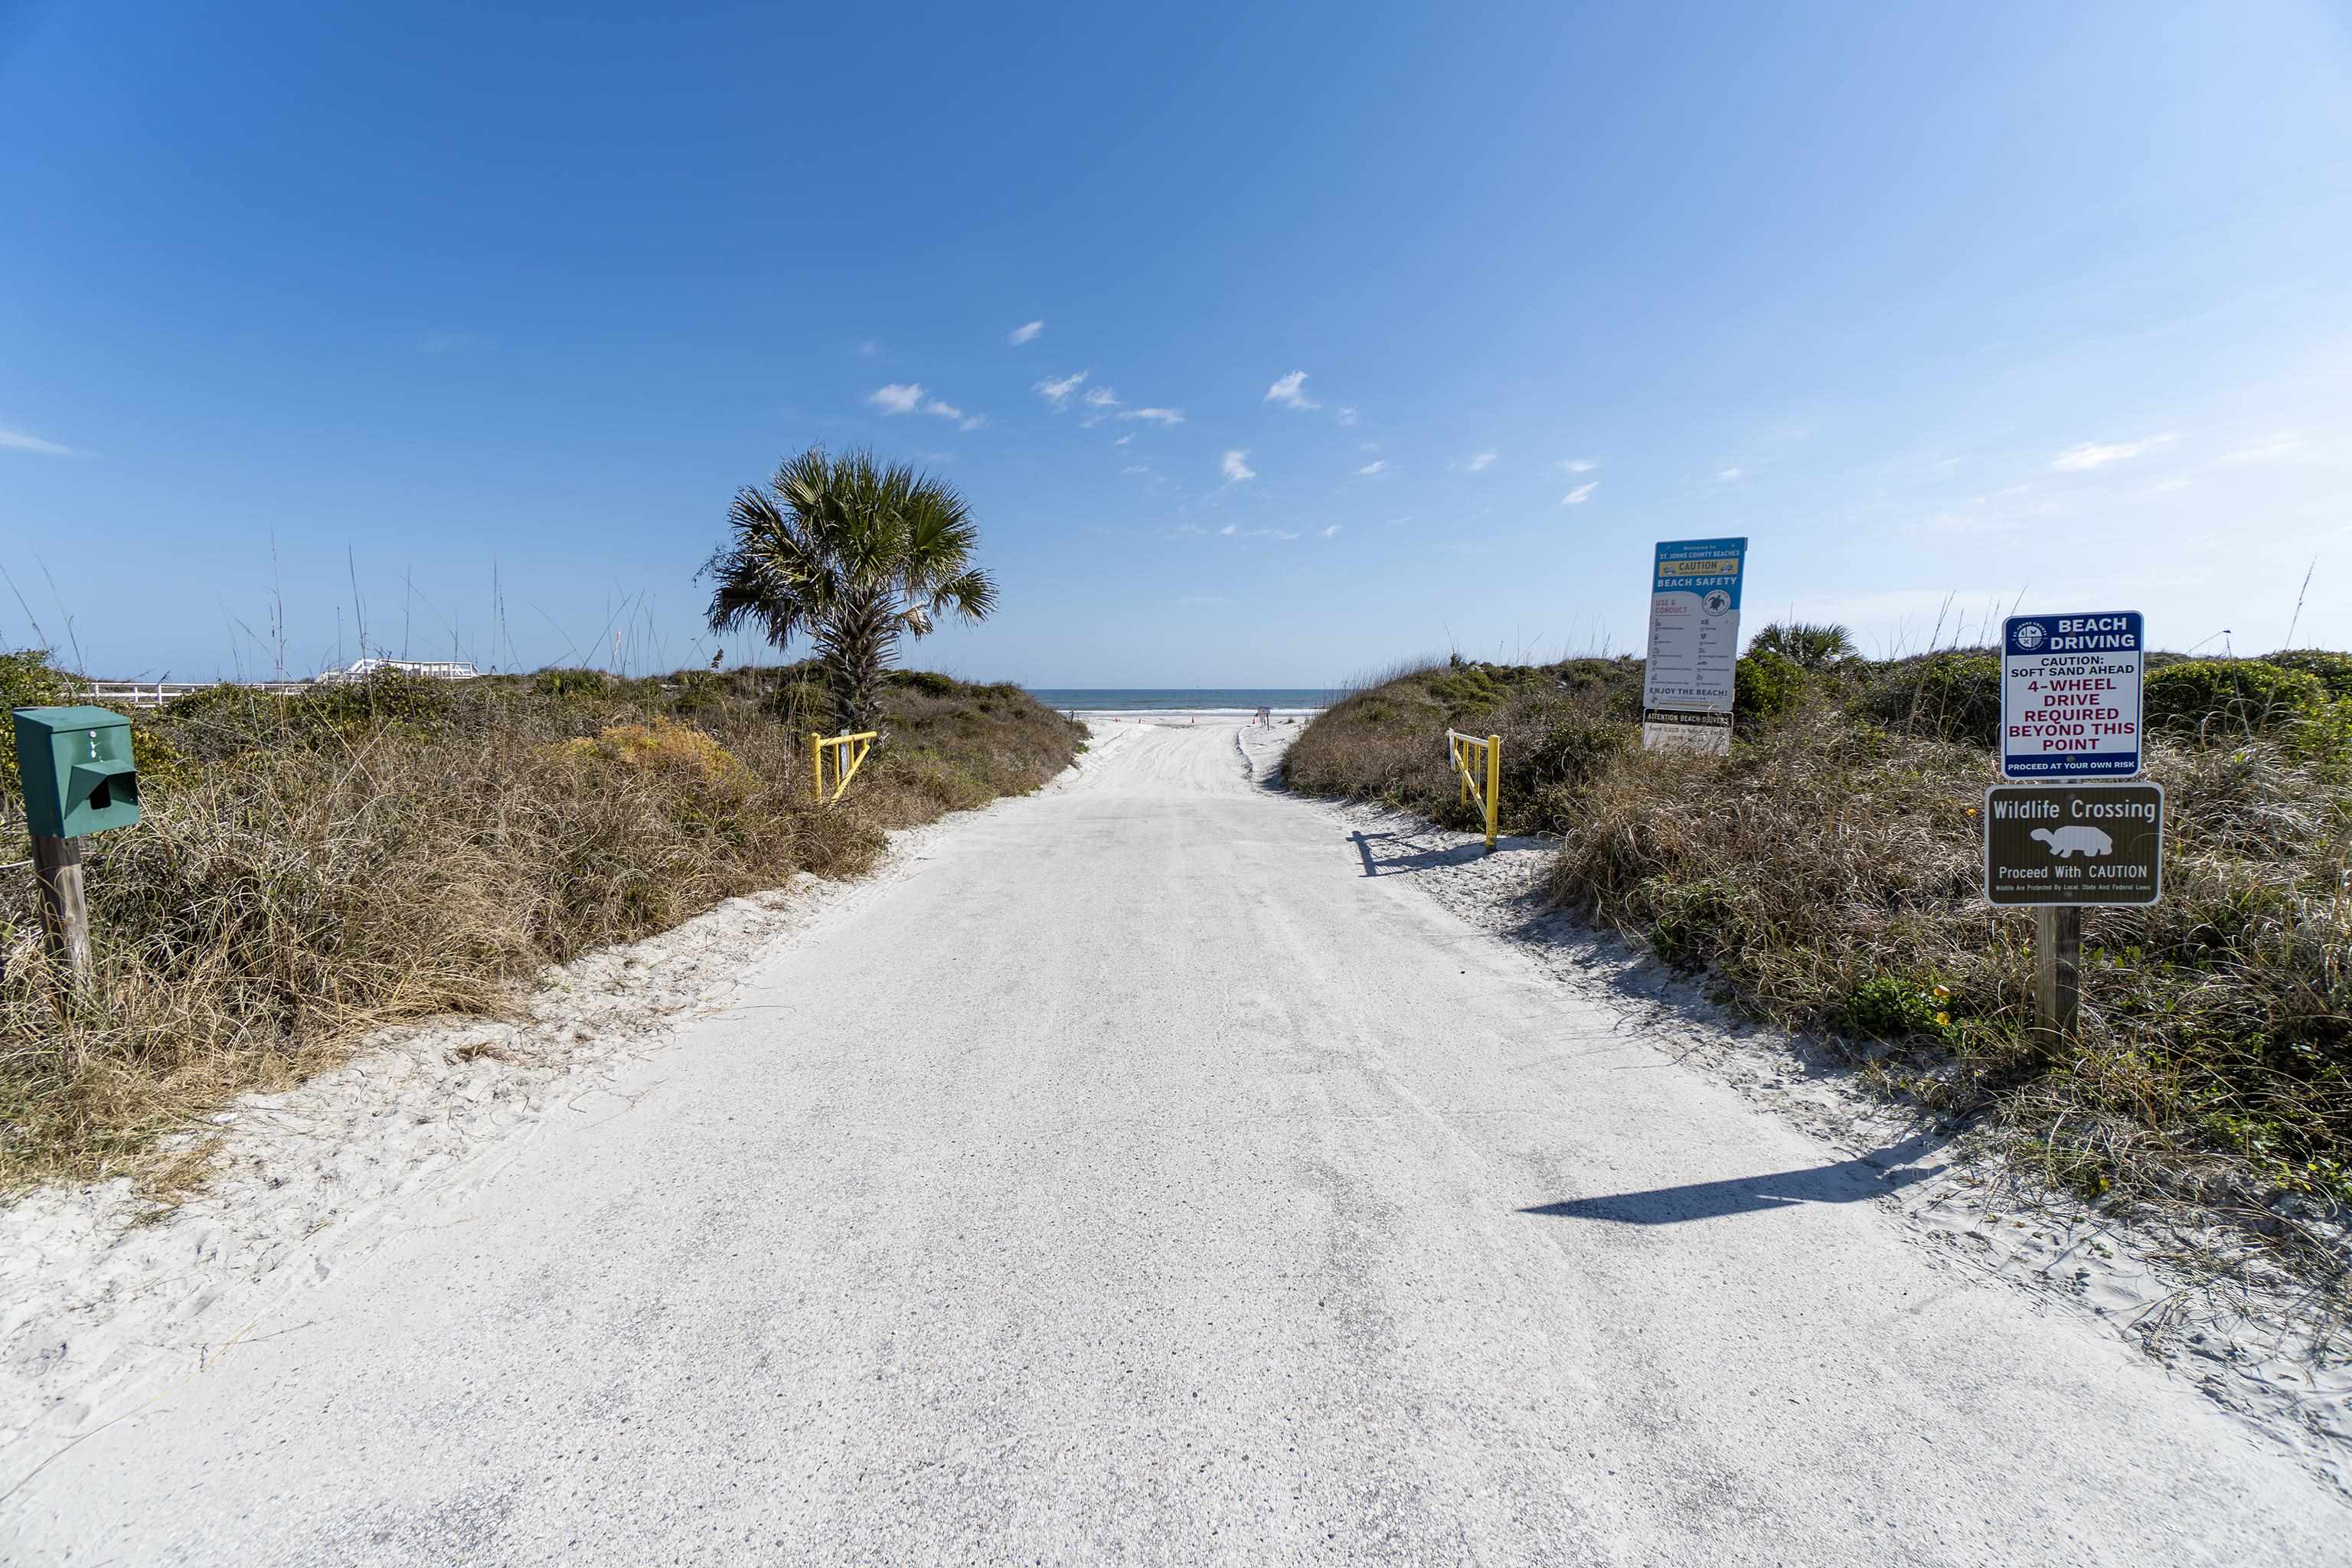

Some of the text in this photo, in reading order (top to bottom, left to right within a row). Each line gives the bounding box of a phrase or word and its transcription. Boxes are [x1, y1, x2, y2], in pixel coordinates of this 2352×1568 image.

[1679, 560, 1717, 570] CAUTION
[1658, 577, 1737, 587] BEACH SAFETY
[1655, 606, 1688, 614] CONDUCT
[2059, 618, 2127, 632] BEACH
[2050, 634, 2135, 650] DRIVING
[2040, 656, 2104, 666] CAUTION:
[2011, 665, 2135, 678] SOFT SAND AHEAD
[2027, 678, 2117, 692] 4-WHEEL
[2044, 694, 2100, 707] DRIVE
[1647, 713, 1678, 721] ATTENTION
[2024, 708, 2119, 724] REQUIRED
[2009, 722, 2135, 737] BEYOND THIS
[2043, 739, 2100, 751] POINT
[1994, 799, 2156, 824] Wildlife Crossing
[1999, 865, 2148, 879] Proceed With CAUTION
